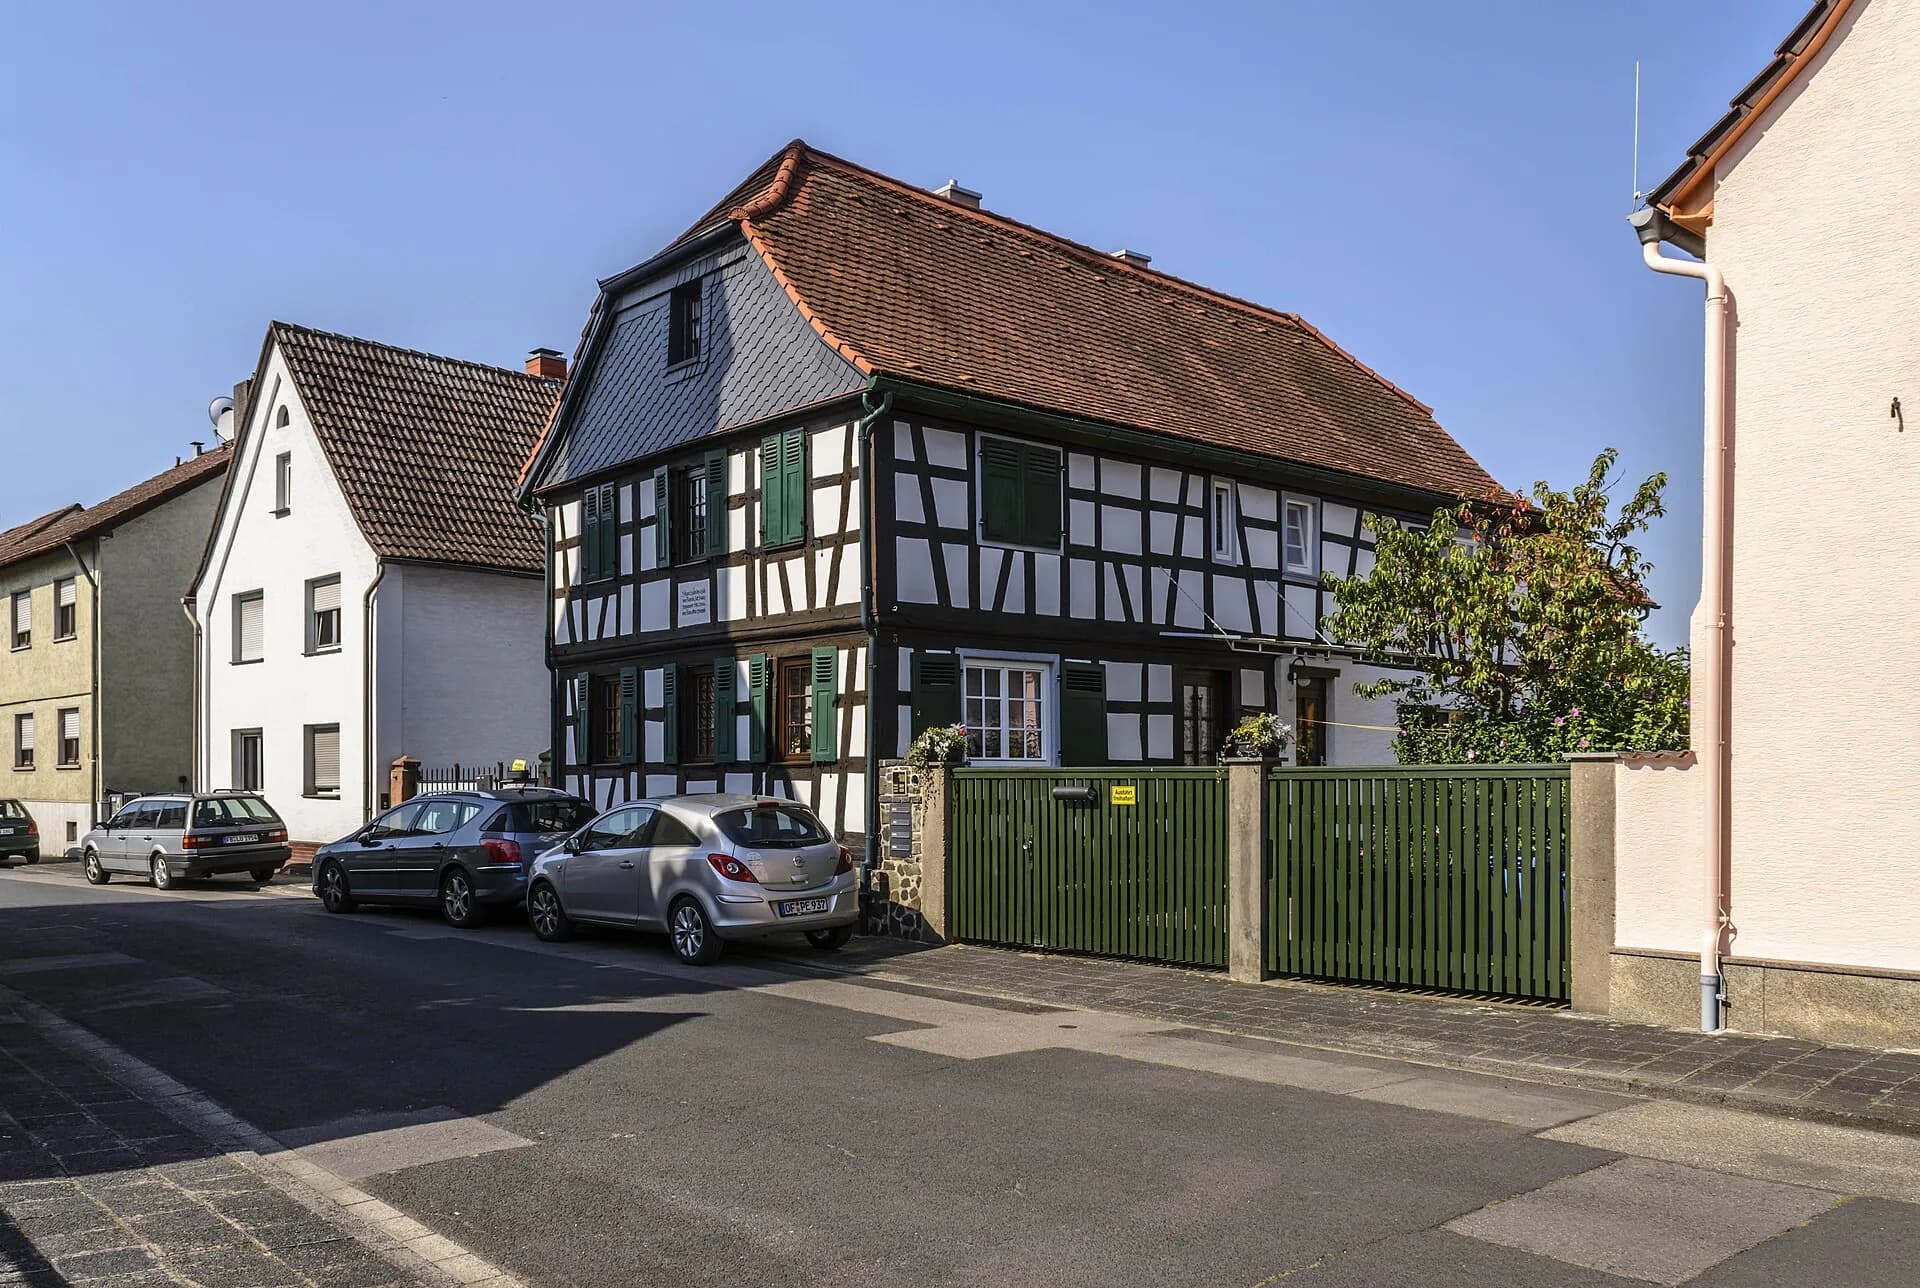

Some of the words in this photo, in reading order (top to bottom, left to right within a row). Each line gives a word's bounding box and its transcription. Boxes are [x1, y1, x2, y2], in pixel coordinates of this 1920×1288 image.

[785, 902, 795, 913] OF
[800, 901, 811, 911] PE
[811, 899, 825, 910] 937
